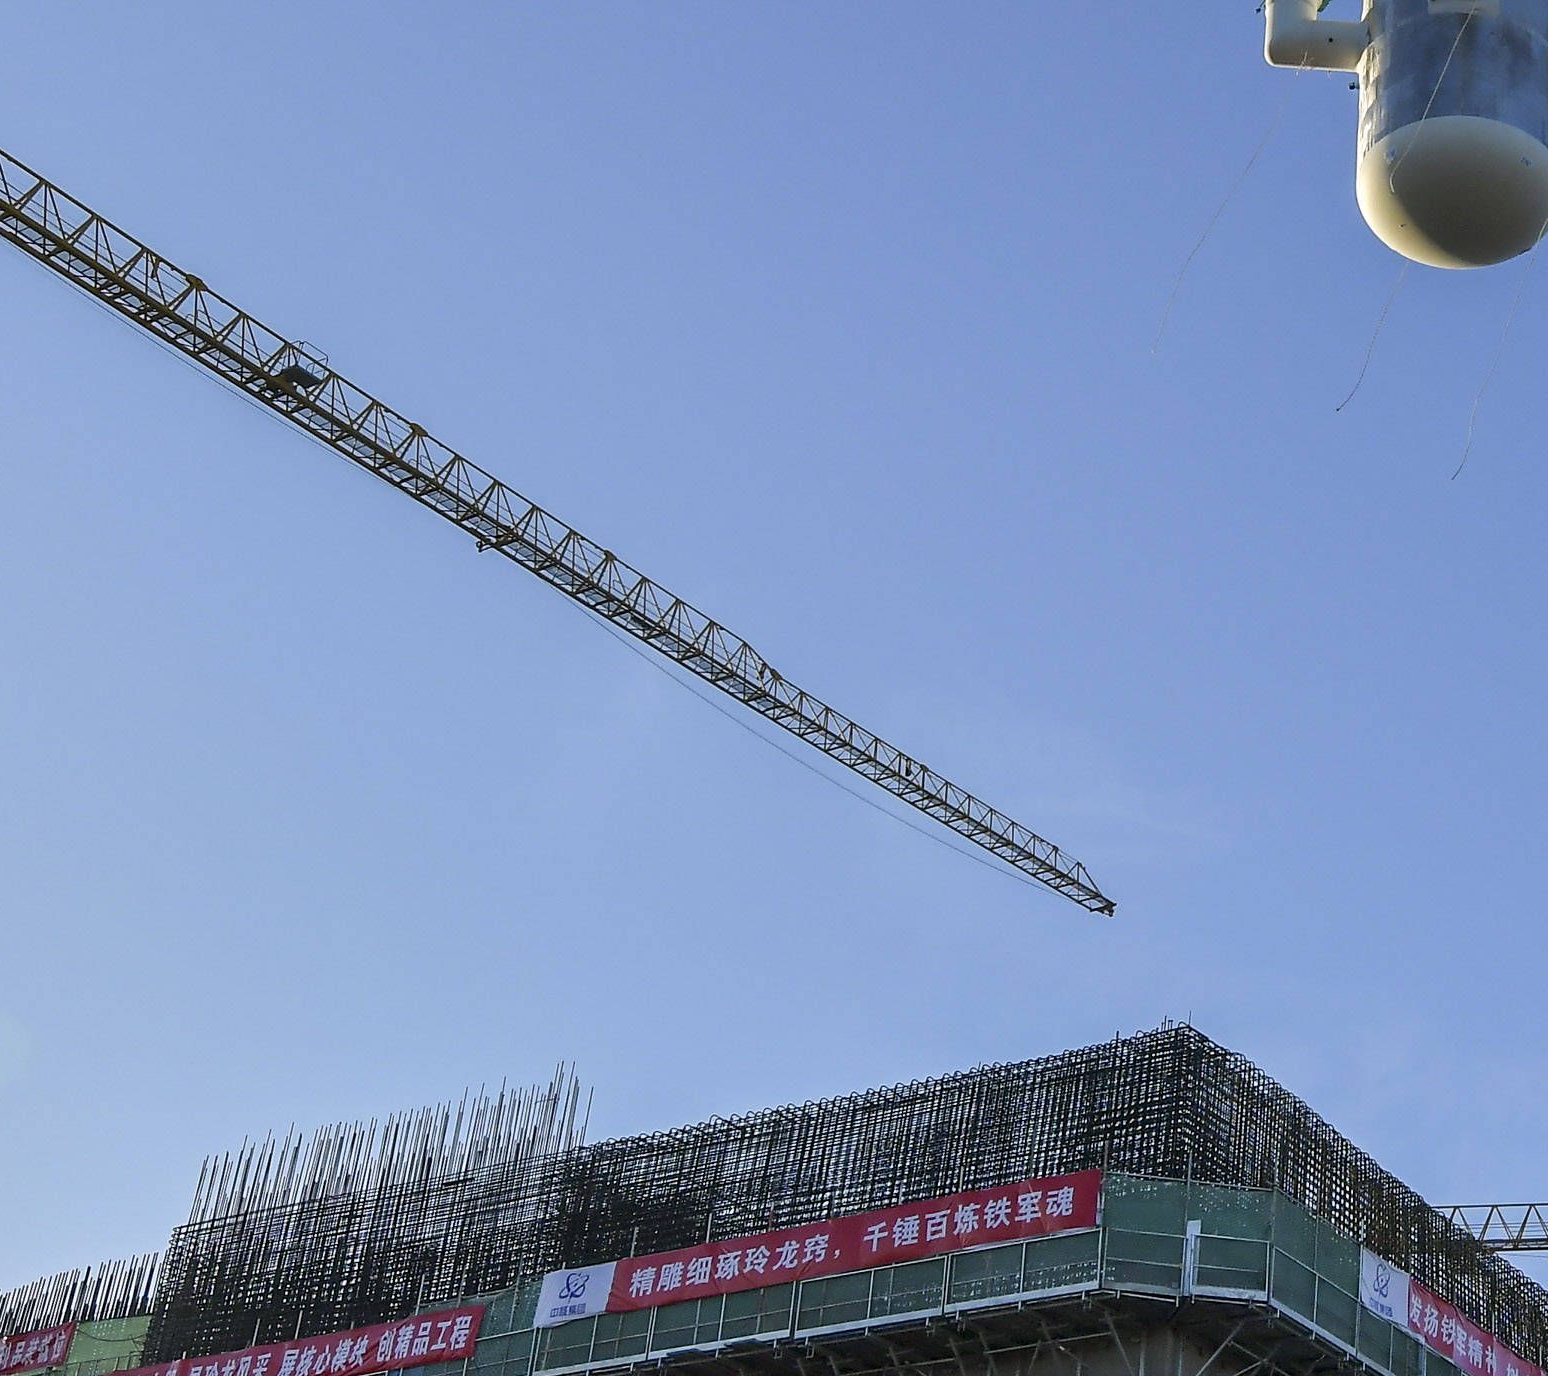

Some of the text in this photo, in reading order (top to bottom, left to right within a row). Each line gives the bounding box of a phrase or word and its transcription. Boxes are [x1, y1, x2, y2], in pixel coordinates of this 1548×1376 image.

[376, 1314, 473, 1363] 创精品工程
